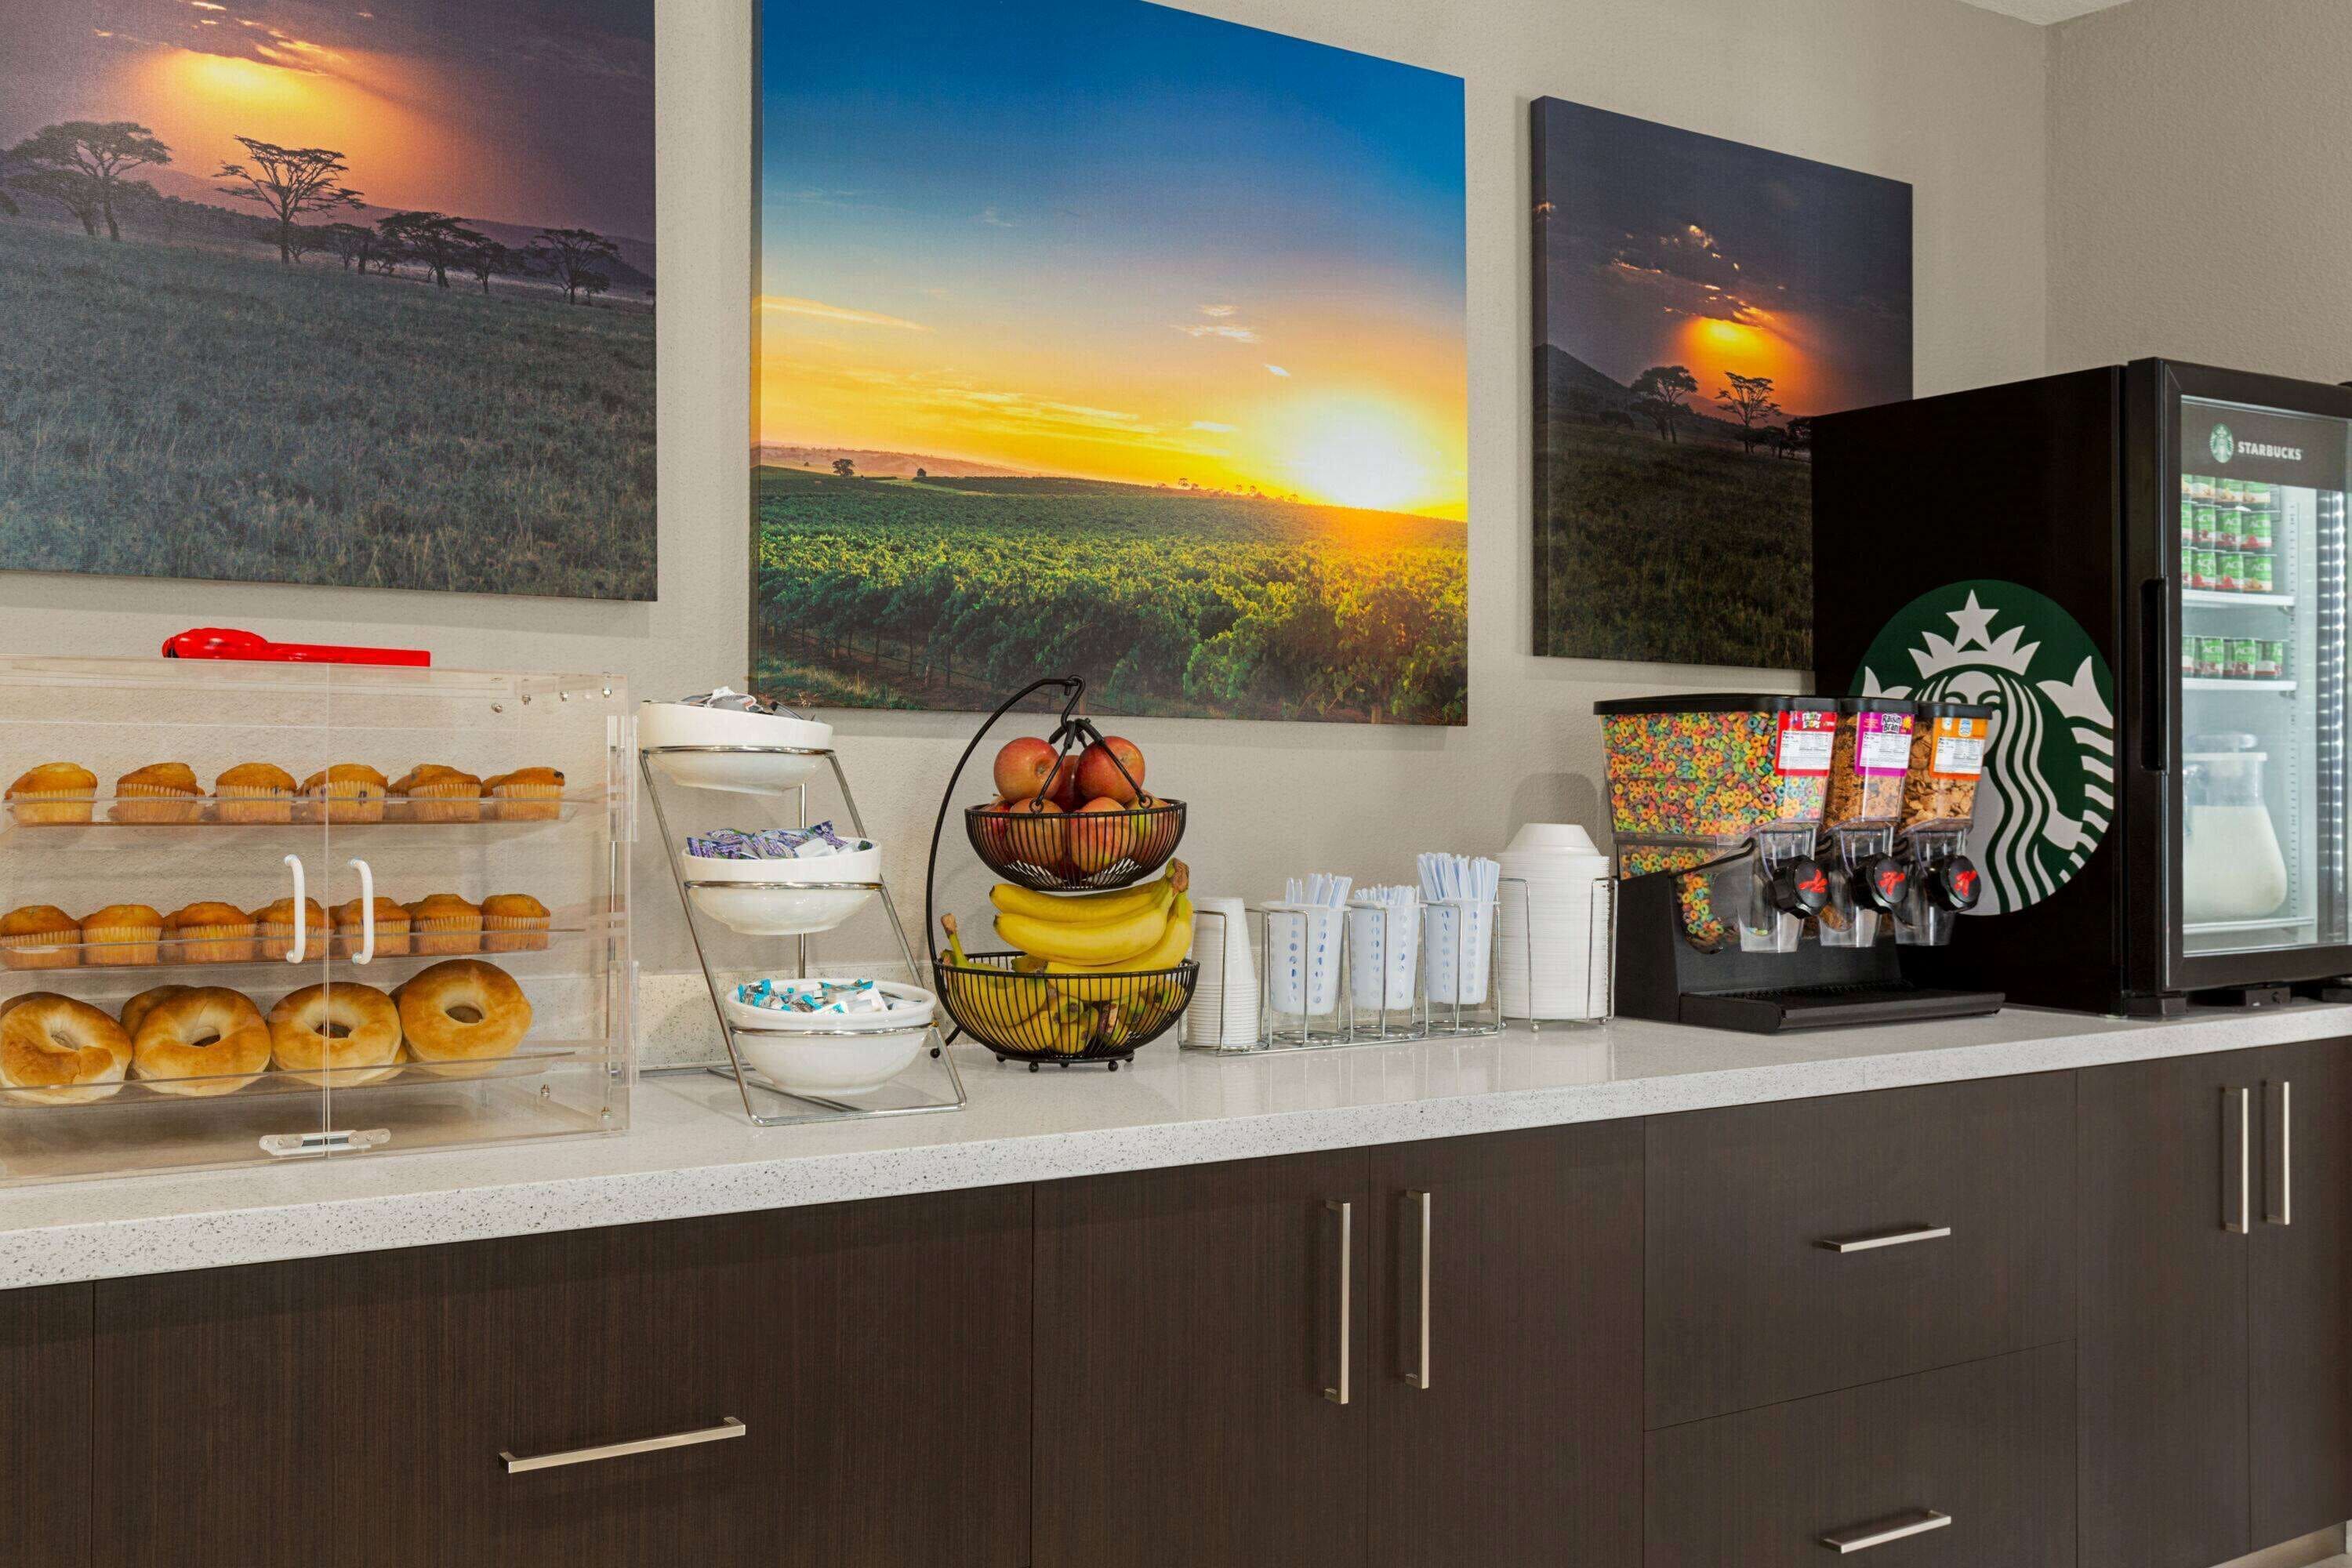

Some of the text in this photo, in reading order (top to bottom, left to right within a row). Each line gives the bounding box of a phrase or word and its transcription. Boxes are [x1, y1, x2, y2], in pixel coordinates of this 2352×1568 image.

[2238, 441, 2302, 460] STARBUCKS
[1882, 713, 1902, 724] Raisin
[1882, 723, 1899, 731] Bran
